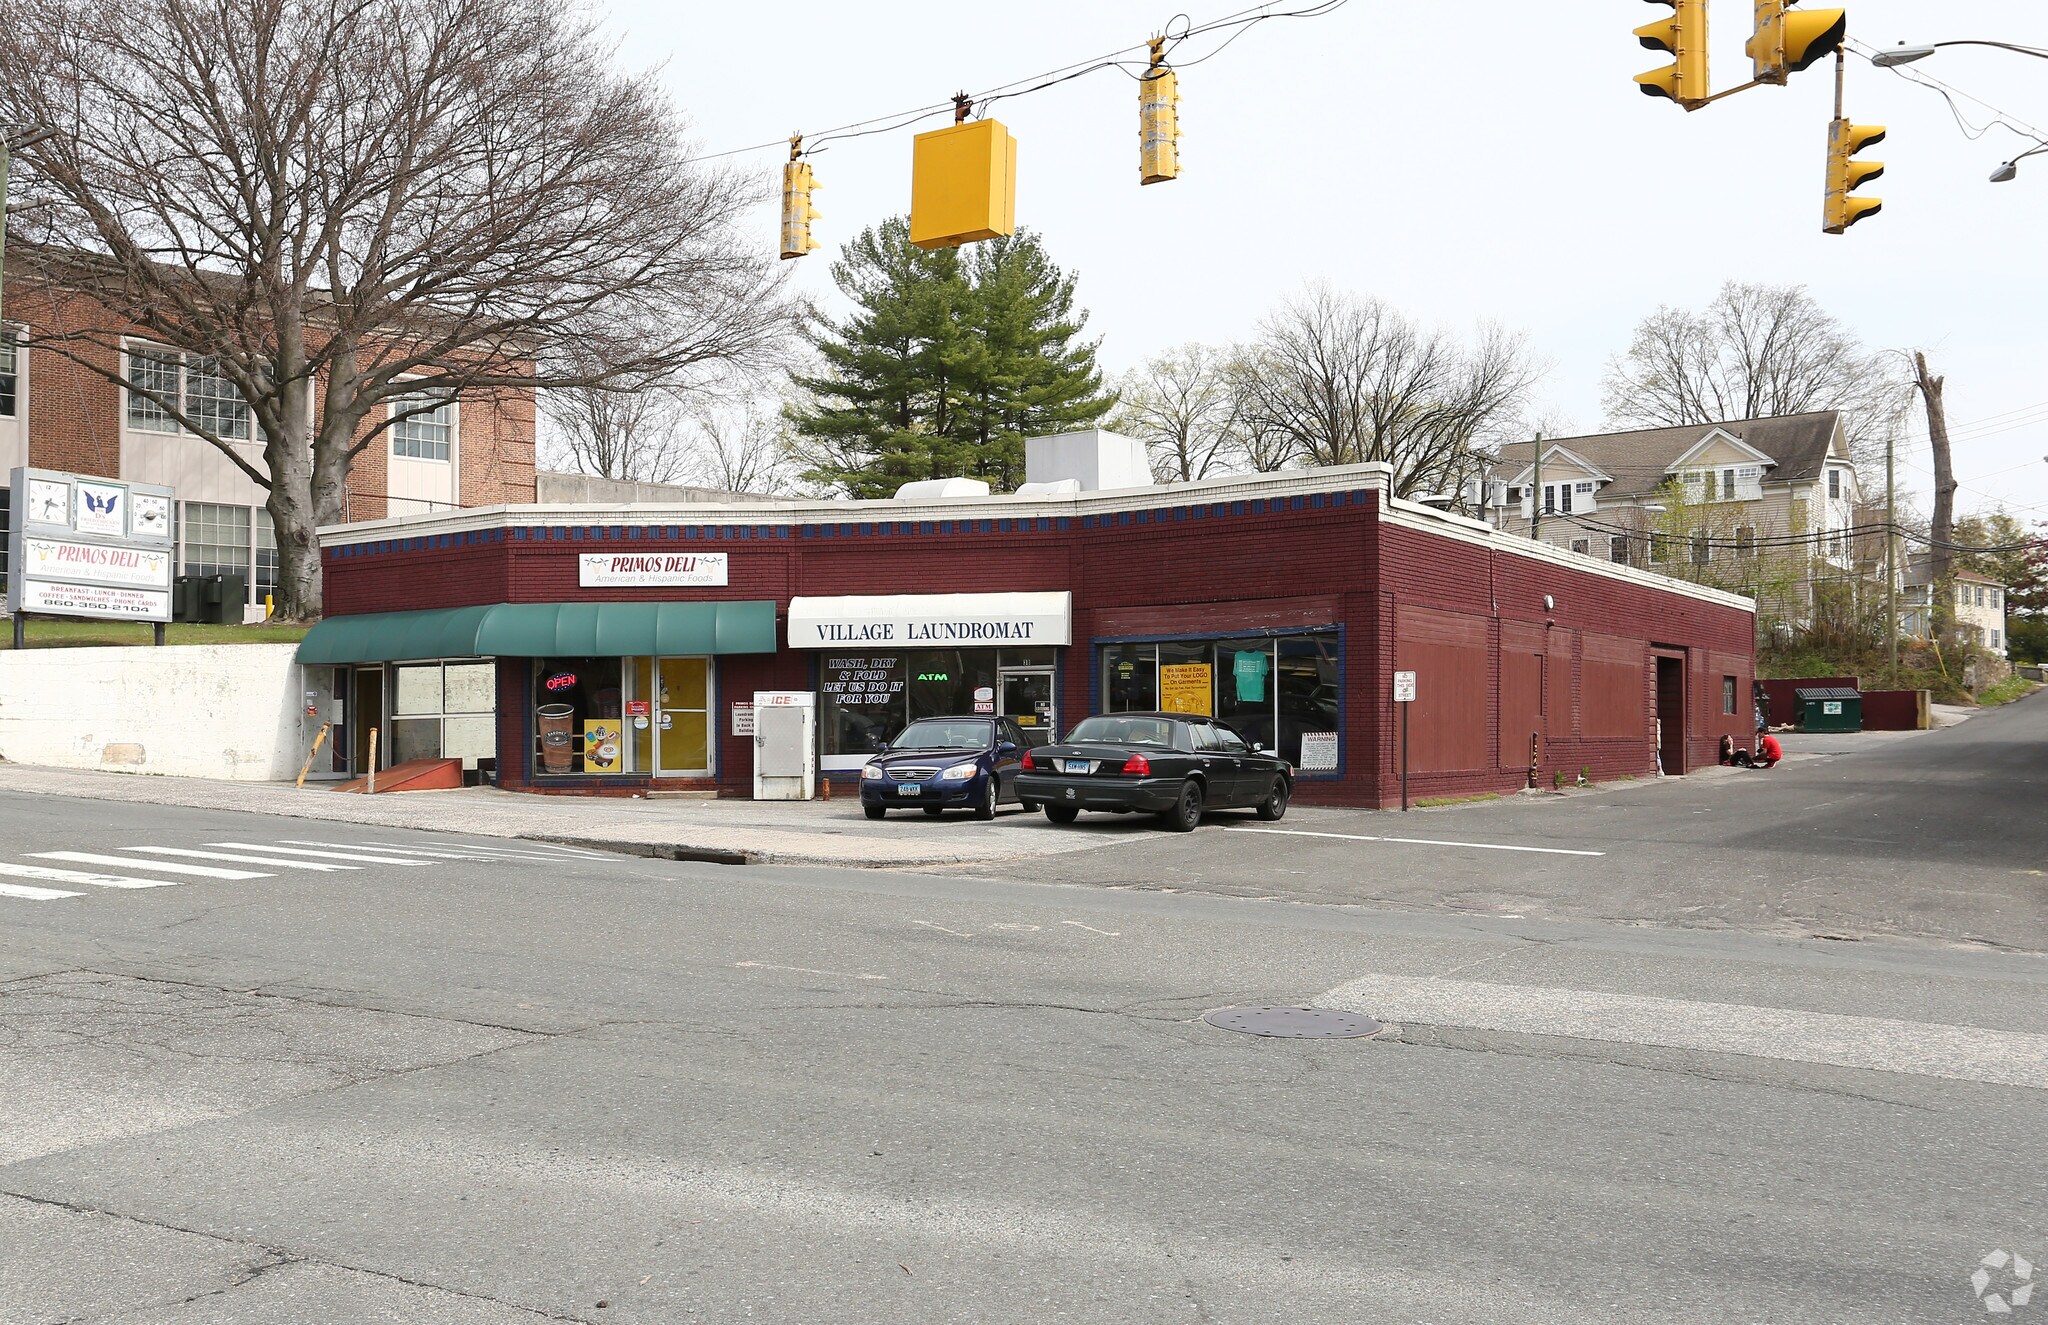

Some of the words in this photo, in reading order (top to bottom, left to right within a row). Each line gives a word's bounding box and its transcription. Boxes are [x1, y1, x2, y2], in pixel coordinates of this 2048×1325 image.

[57, 546, 108, 564] PRIMOS
[110, 550, 140, 568] DELI
[611, 557, 662, 572] PRIMOS
[664, 557, 696, 572] DELI
[40, 564, 81, 575] American
[94, 568, 128, 581] Hispanic
[131, 573, 155, 582] Foods
[648, 574, 685, 583] Hispanic
[688, 574, 713, 582] Foods
[51, 586, 89, 594] BREAKFAST
[70, 595, 109, 603] SANDWICHES
[44, 599, 149, 612] 860-350-2104
[817, 623, 894, 641] VILLAGE
[907, 622, 1034, 640] LAUNDROMAT
[829, 658, 867, 669] WASH,
[870, 658, 897, 668] DRY
[839, 671, 851, 680] &
[854, 671, 887, 680] FOLD
[547, 674, 576, 689] OPEN
[823, 683, 846, 693] LET
[849, 683, 865, 692] US
[868, 682, 888, 692] DO
[890, 682, 903, 692] IT
[771, 696, 792, 704] ICE
[836, 694, 862, 704] FOR
[864, 694, 890, 704] YOU
